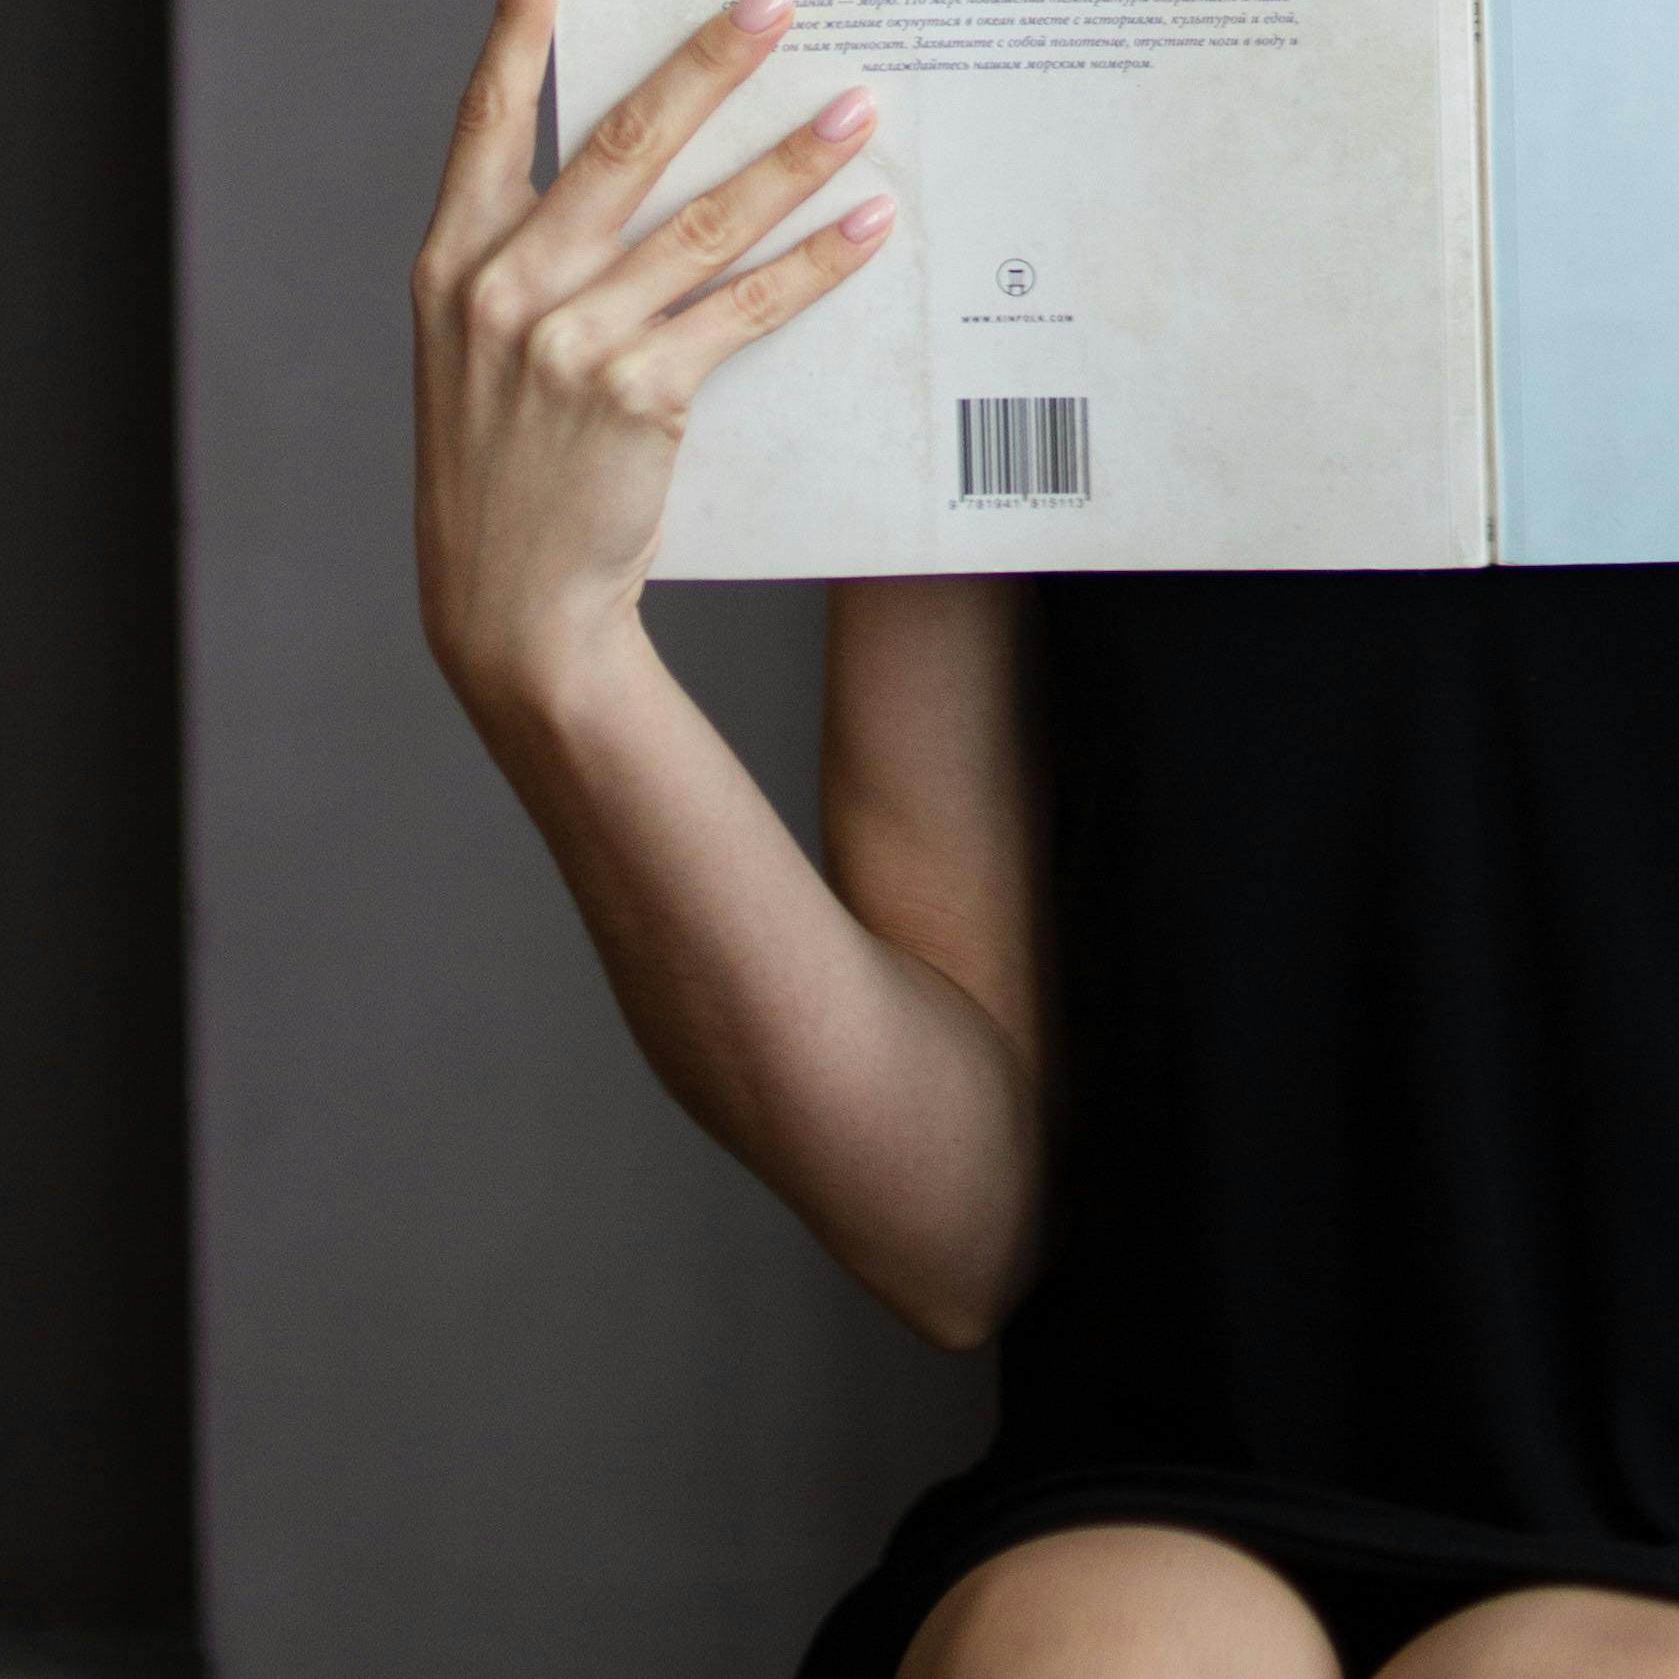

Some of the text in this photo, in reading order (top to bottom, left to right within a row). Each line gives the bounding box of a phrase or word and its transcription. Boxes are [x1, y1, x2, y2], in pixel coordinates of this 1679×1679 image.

[825, 18, 882, 29] желание
[886, 18, 960, 31] окунуться
[976, 16, 1015, 26] океан
[1019, 16, 1070, 25] вместе
[1084, 13, 1167, 29] историями,
[1171, 12, 1247, 28] культурой
[1264, 12, 1299, 25] едой,
[782, 44, 798, 52] он
[803, 42, 830, 51] нам
[834, 40, 908, 54] приносит.
[913, 36, 993, 49] Захватите
[1007, 35, 1046, 48] собой
[1133, 37, 1205, 50] опустите
[1208, 37, 1238, 46] ноги
[1254, 34, 1285, 50] воду
[862, 58, 969, 71] наслаждайтесь
[973, 60, 1021, 70] нашим
[1024, 60, 1086, 73] морским
